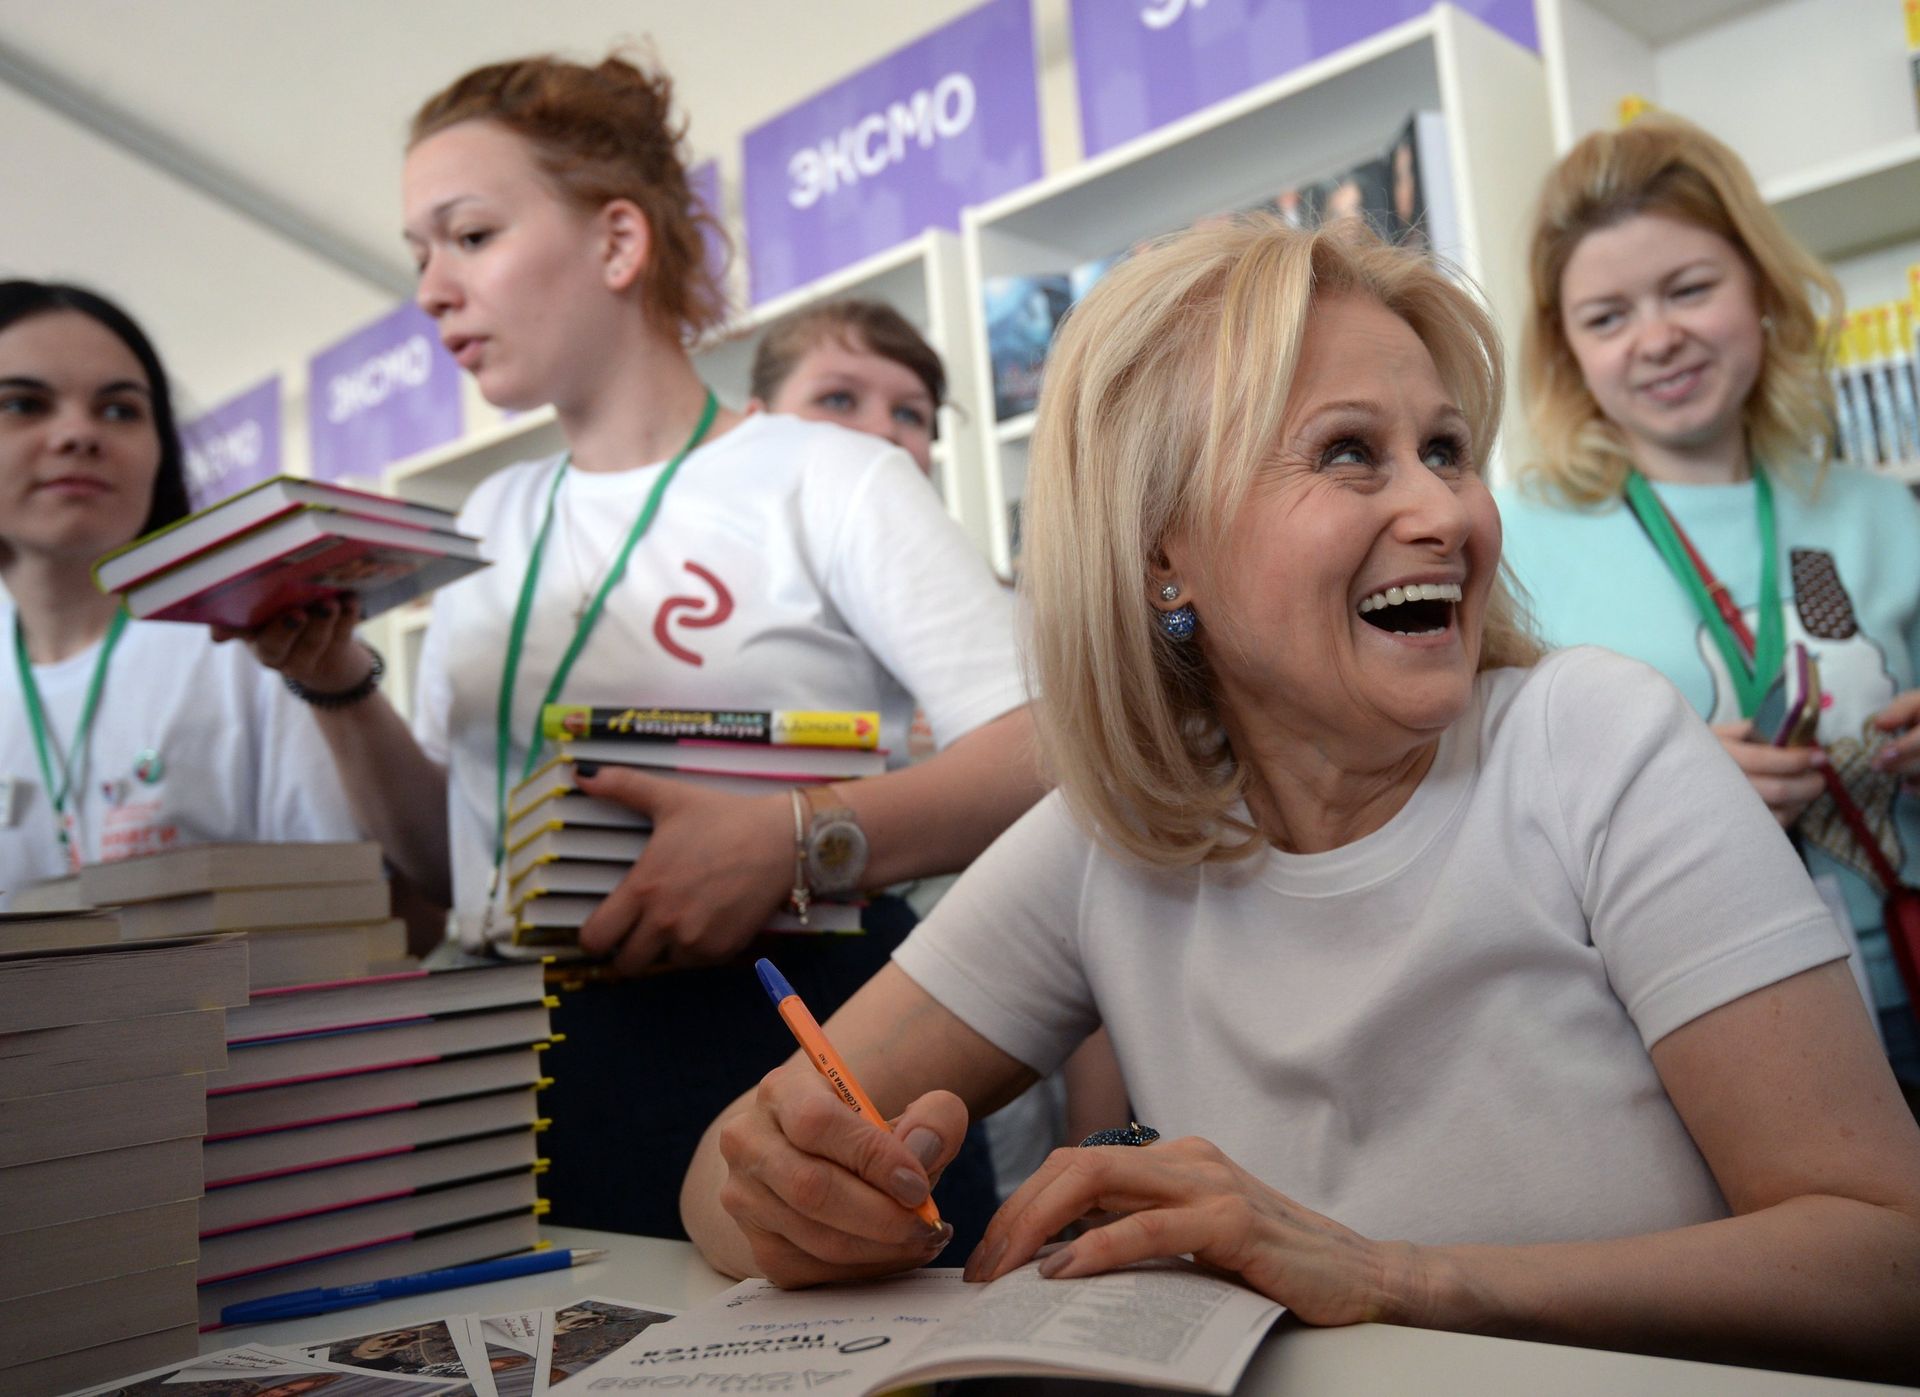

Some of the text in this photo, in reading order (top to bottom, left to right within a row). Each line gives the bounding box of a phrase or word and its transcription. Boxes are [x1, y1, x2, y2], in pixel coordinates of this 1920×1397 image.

[788, 71, 977, 210] ЭКСМО
[328, 333, 432, 425] ЭКСМО
[827, 1067, 838, 1078] 51
[834, 1076, 857, 1106] CORVINA
